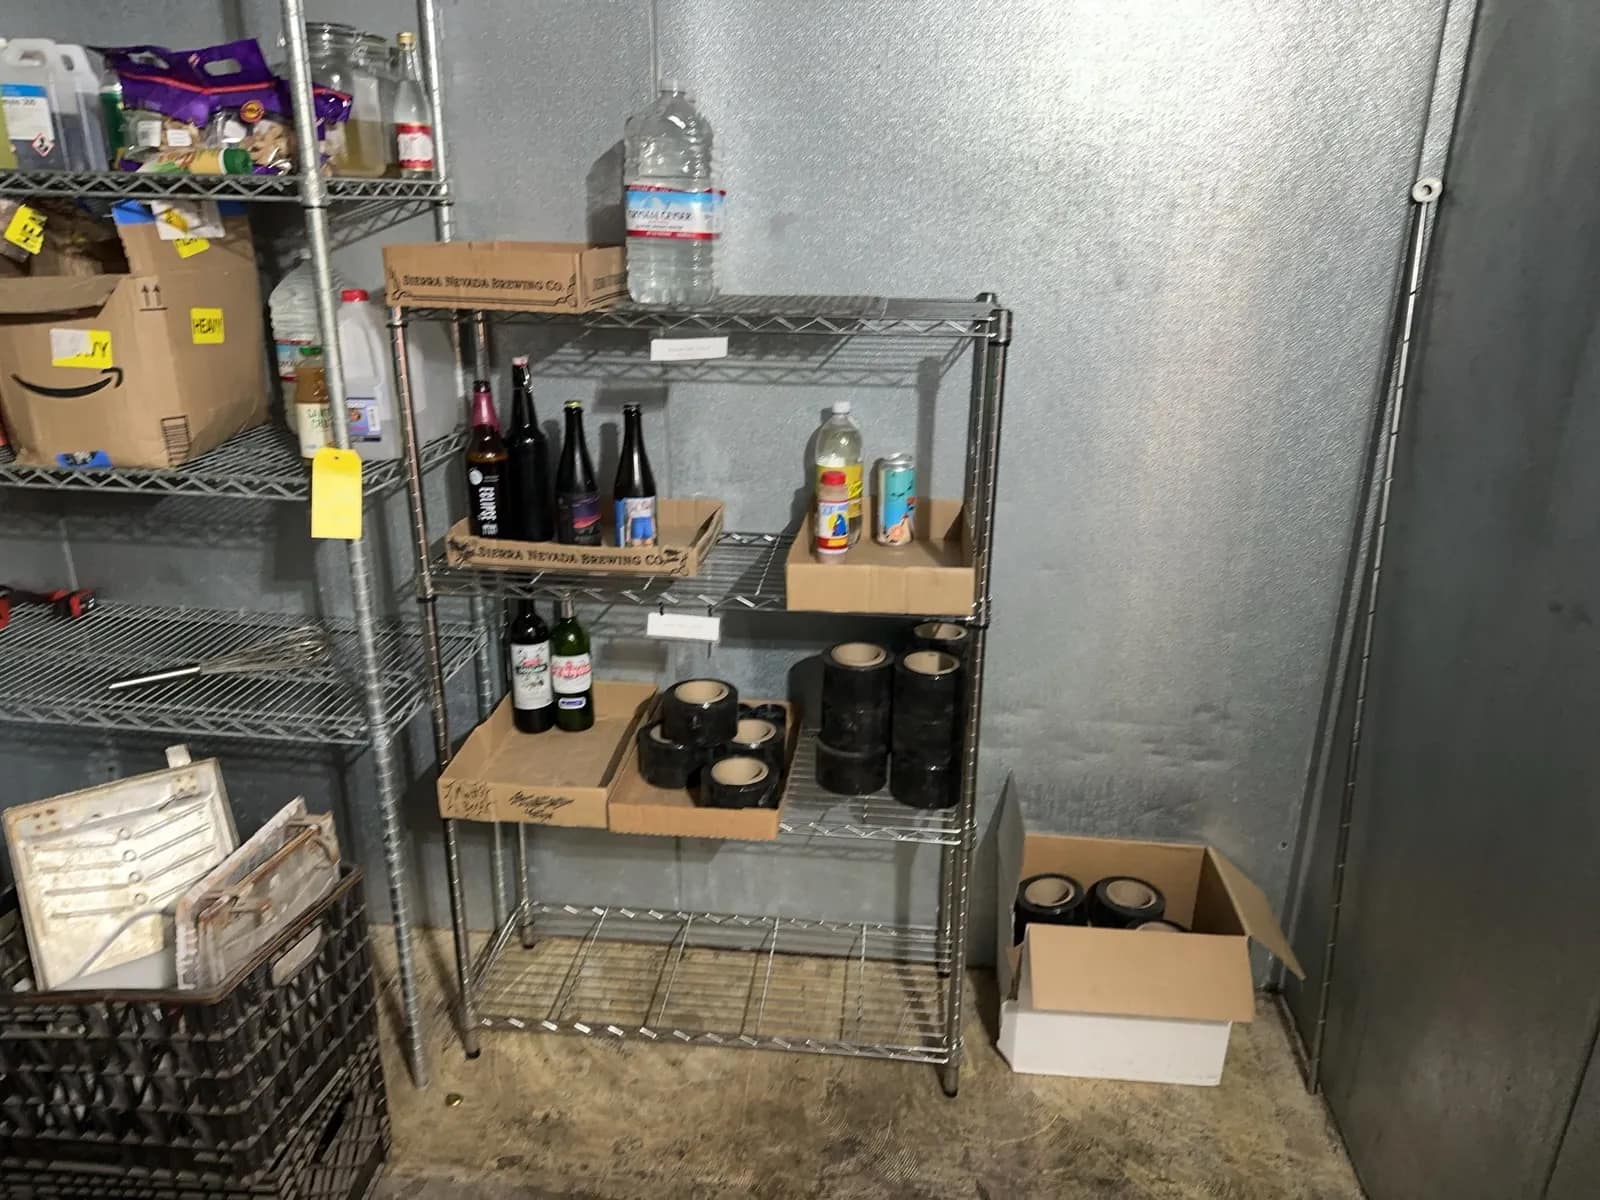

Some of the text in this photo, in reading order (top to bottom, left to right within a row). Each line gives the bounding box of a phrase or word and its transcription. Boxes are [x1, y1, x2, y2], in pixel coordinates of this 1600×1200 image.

[402, 274, 441, 287] SIERRA
[446, 275, 489, 288] NEVADA
[491, 277, 542, 291] BREWING
[479, 546, 523, 561] SIERRA
[528, 548, 578, 564] NEVADA
[581, 551, 641, 566] BREWING
